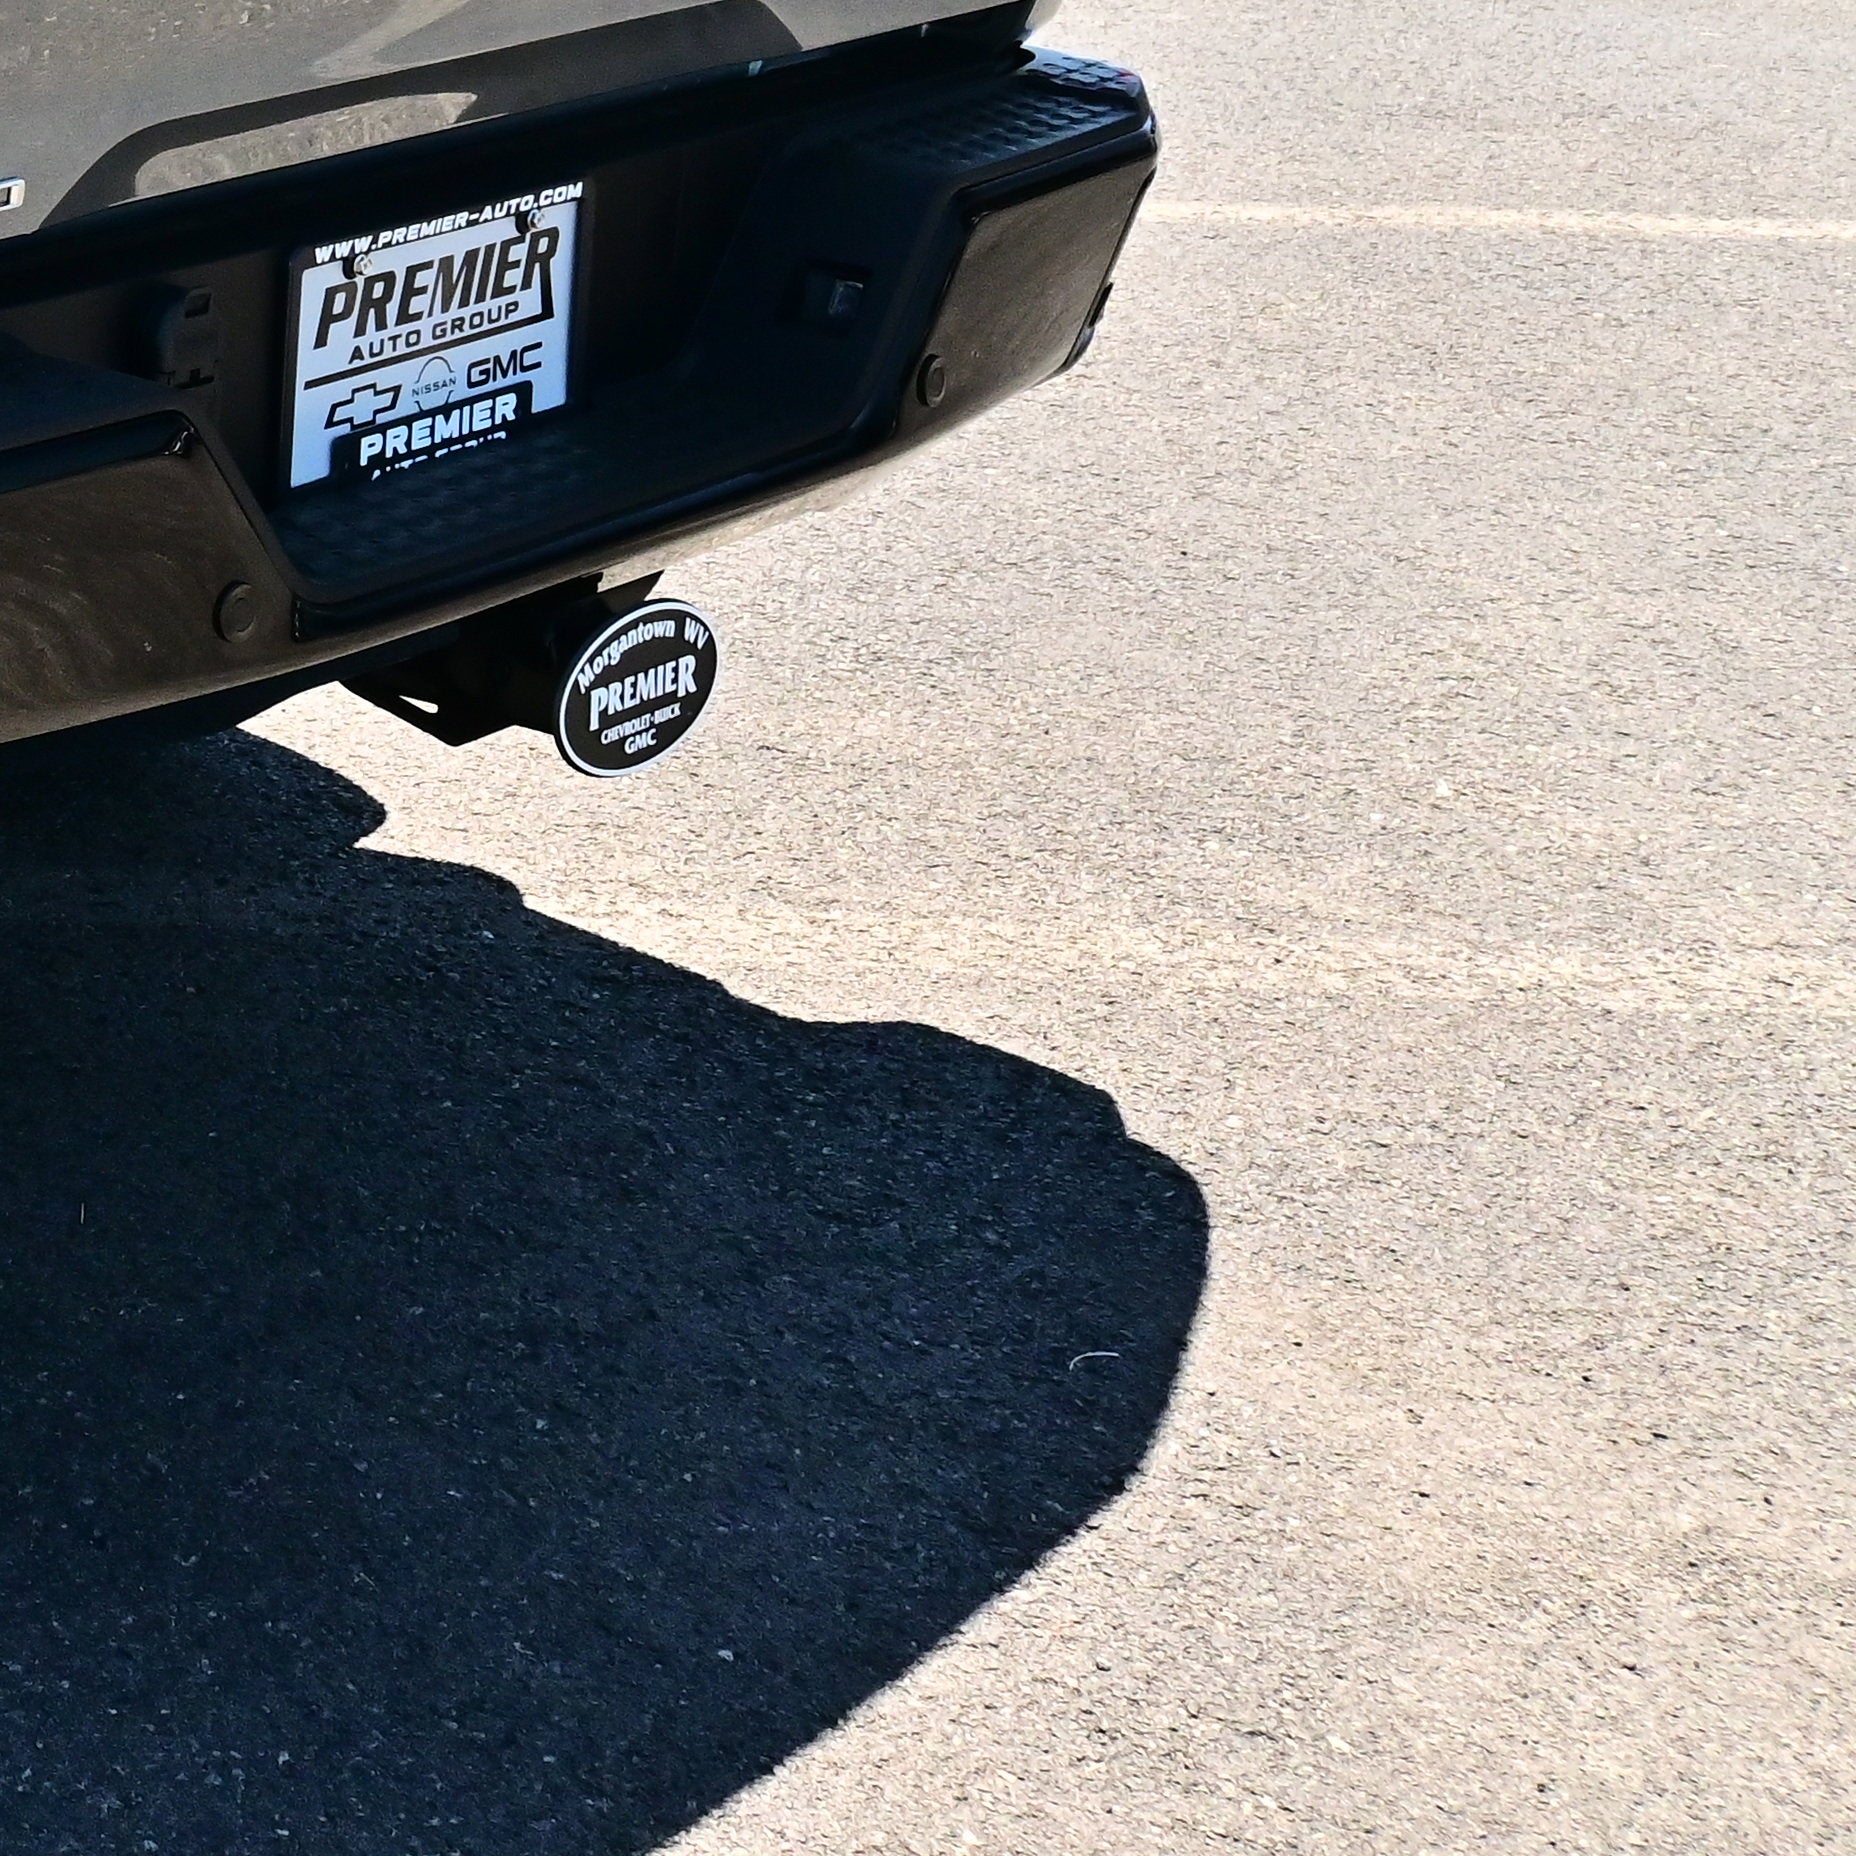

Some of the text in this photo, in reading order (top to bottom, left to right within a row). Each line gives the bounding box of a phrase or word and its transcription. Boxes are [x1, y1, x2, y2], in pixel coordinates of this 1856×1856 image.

[314, 181, 584, 264] WWW.PREMIER-AUTO.COM
[314, 225, 560, 350] PREMIER
[348, 300, 520, 364] AUTO GROUP
[466, 341, 543, 389] GMC
[411, 376, 457, 398] NISSAN
[359, 392, 518, 467] PREMIER
[577, 617, 710, 695] Morgantown WV
[589, 654, 698, 732] PREMIER
[624, 728, 658, 755] GMC
